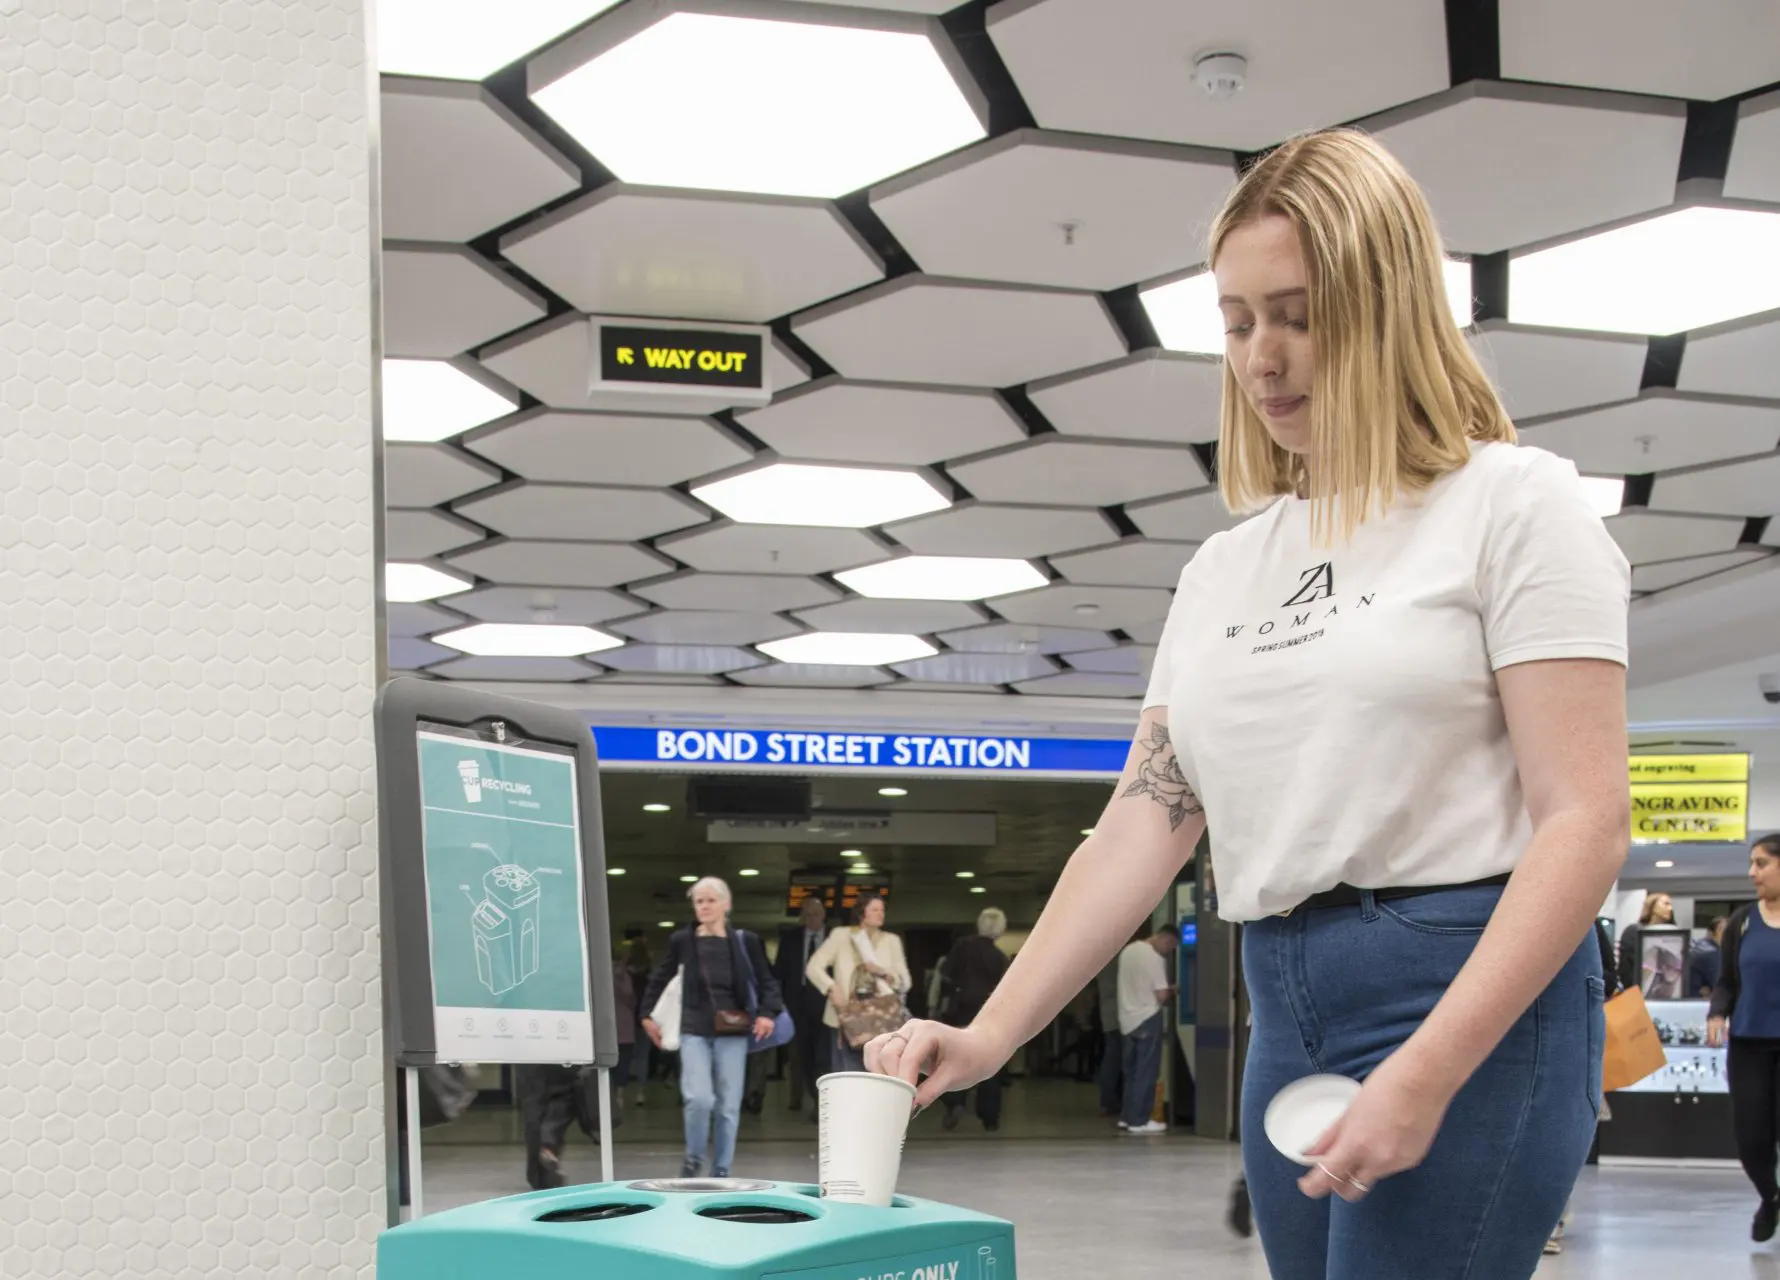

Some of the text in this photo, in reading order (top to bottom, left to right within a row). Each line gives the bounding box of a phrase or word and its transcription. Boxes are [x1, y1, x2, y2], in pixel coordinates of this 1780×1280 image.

[643, 347, 747, 372] WAY OUT
[657, 730, 1031, 768] BOND STREET STATION
[481, 777, 532, 796] RECYCLING
[1631, 796, 1739, 811] NGRAVING
[1639, 817, 1720, 832] CENTRE
